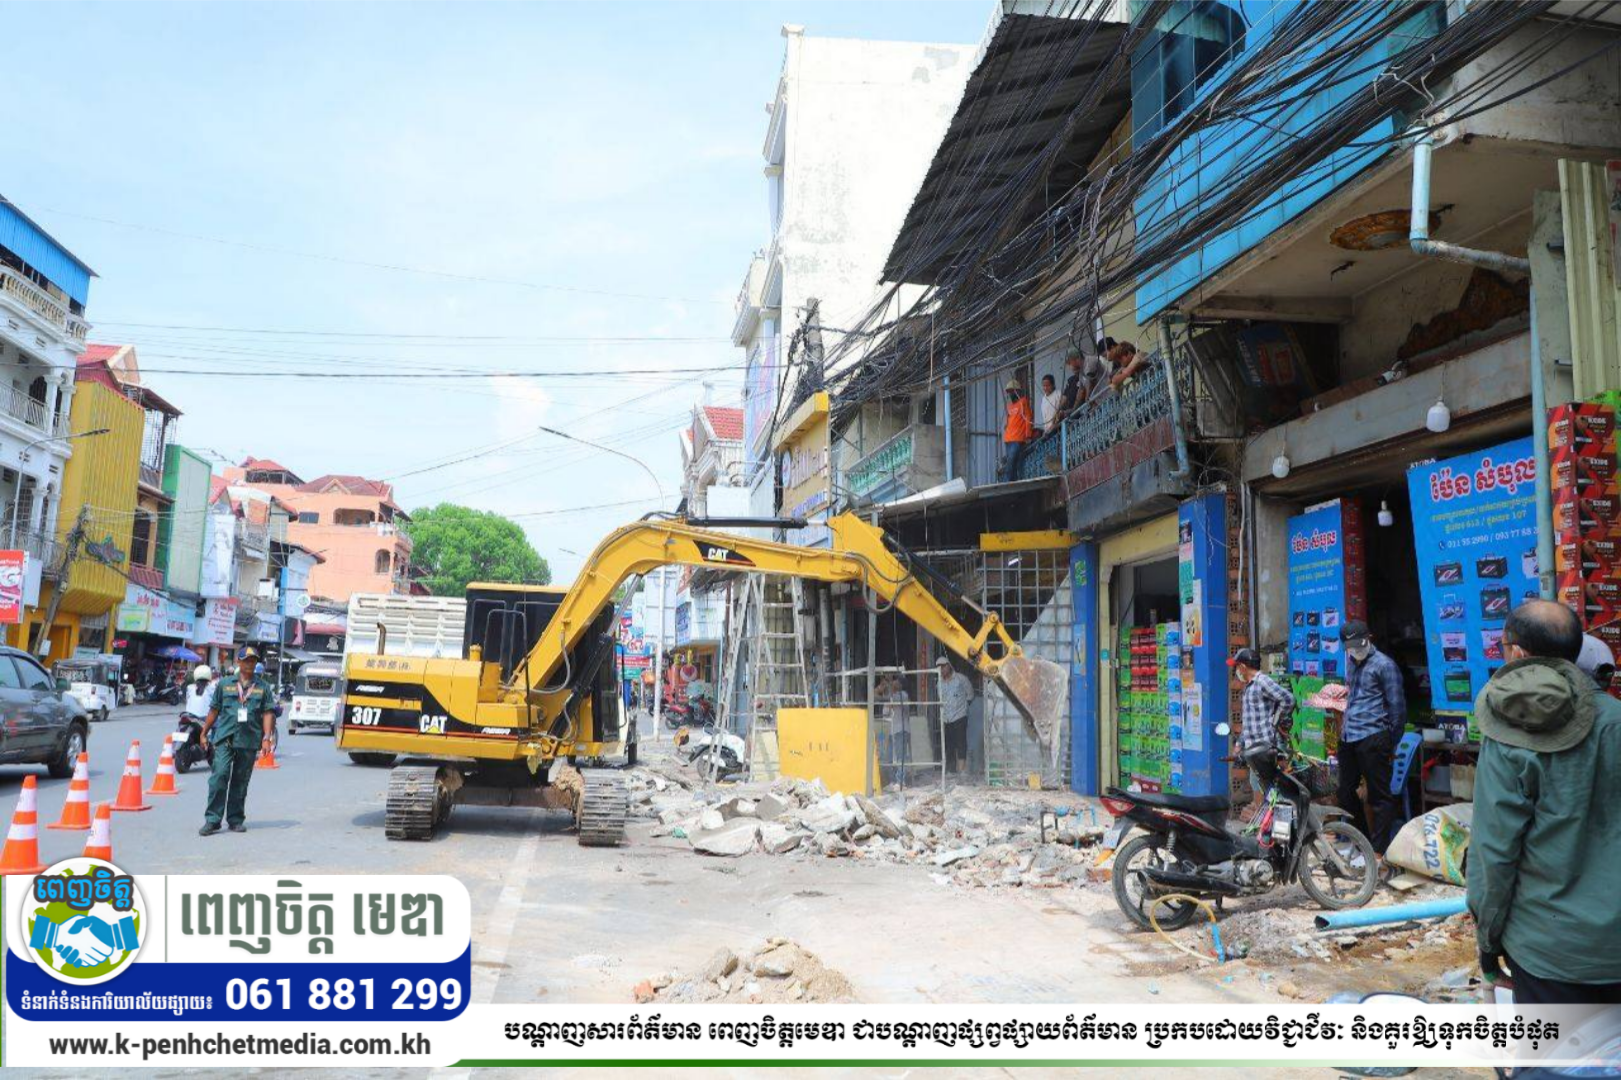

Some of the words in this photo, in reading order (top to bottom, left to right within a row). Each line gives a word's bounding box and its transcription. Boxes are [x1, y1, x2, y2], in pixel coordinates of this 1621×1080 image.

[707, 547, 729, 561] CAT
[351, 706, 382, 726] 307
[419, 715, 448, 735] CAT
